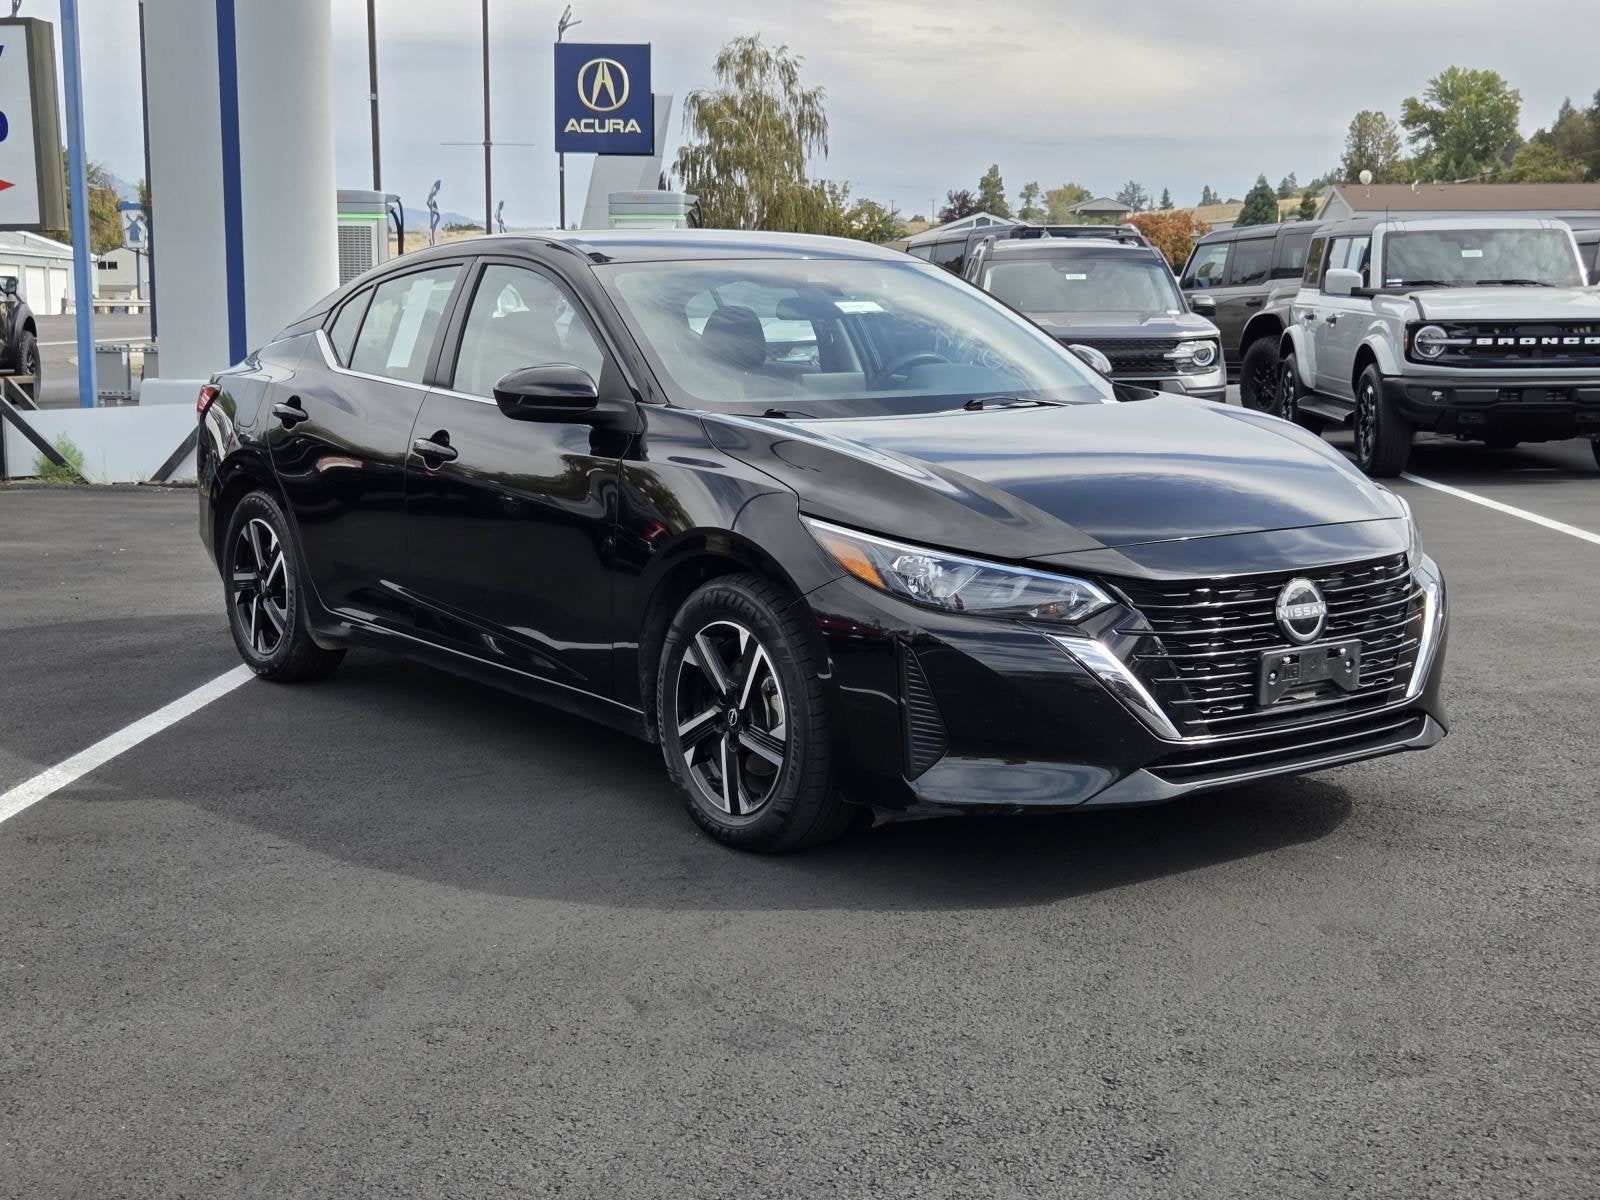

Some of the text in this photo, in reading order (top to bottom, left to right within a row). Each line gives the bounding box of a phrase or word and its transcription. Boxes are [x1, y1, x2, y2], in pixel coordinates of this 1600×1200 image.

[564, 118, 642, 134] ACURA
[1476, 337, 1600, 345] BRONCO
[1278, 604, 1327, 618] NISSAN
